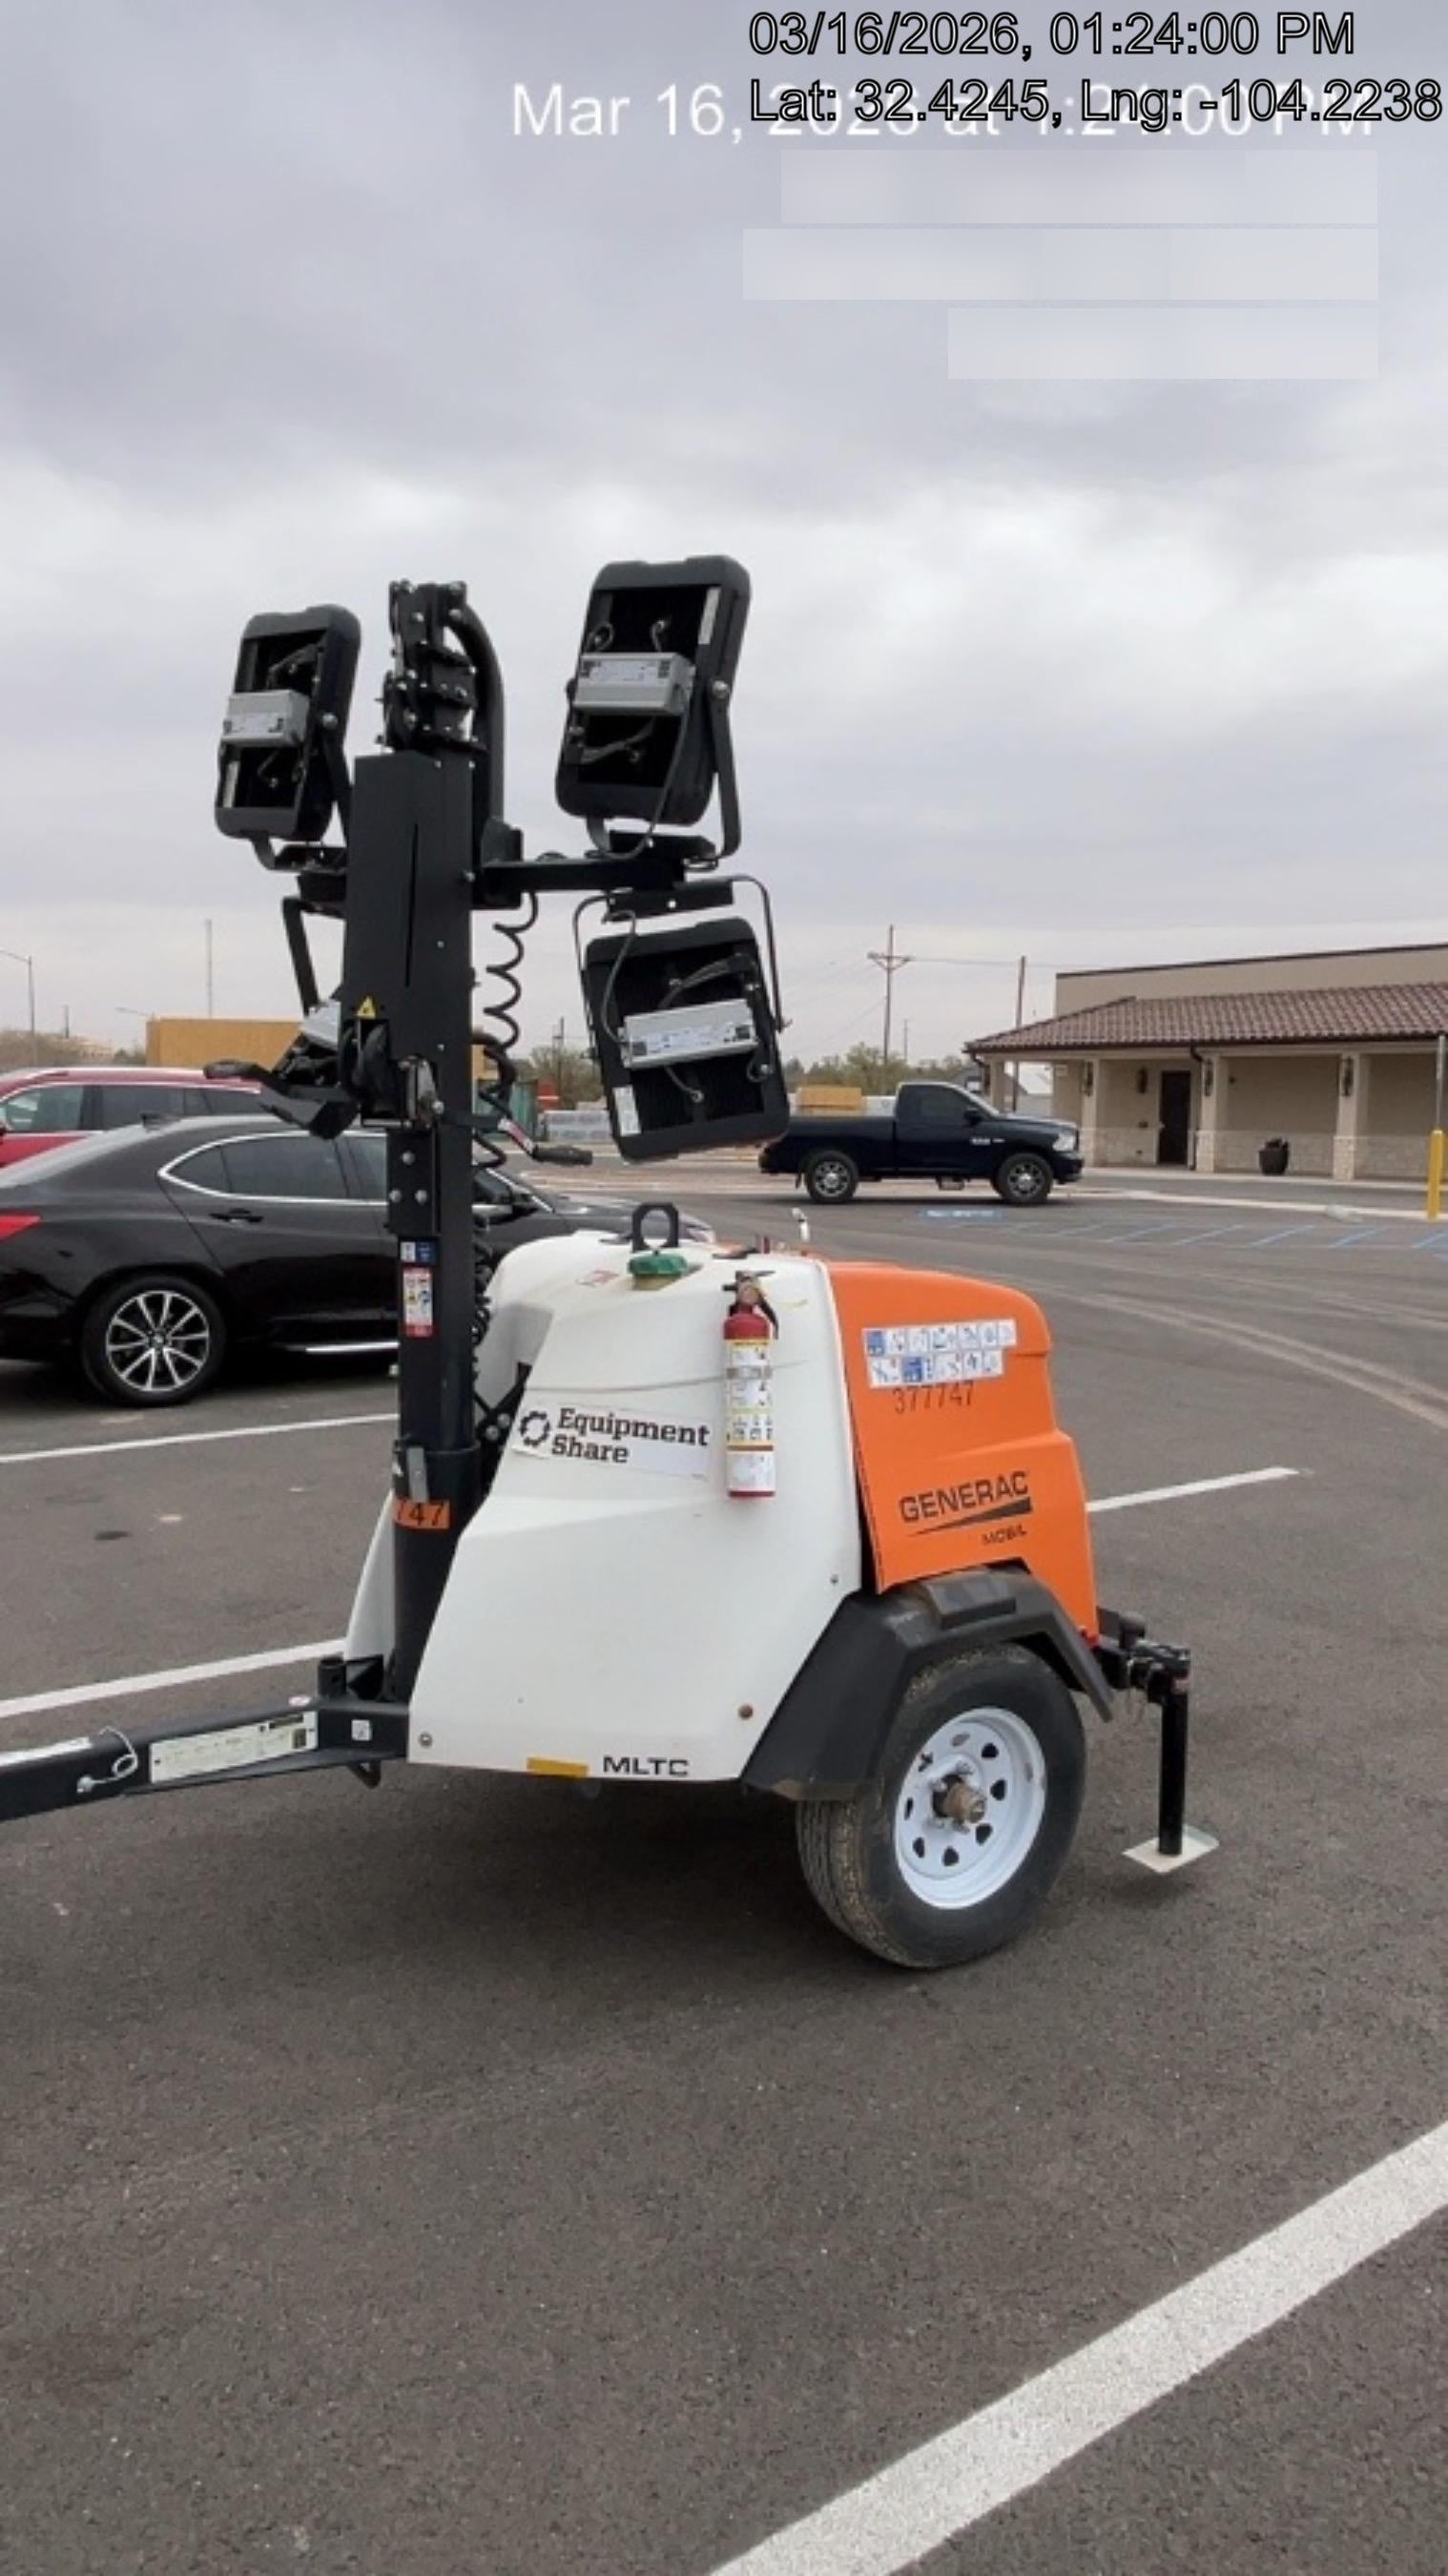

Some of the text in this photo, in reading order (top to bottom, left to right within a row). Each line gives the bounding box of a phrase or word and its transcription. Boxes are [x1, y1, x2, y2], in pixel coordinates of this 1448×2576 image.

[892, 1380, 974, 1413] 377747
[557, 1407, 710, 1446] Equipment
[551, 1434, 629, 1464] Share
[899, 1470, 1028, 1523] GENERAC
[603, 1755, 689, 1776] MLTC
